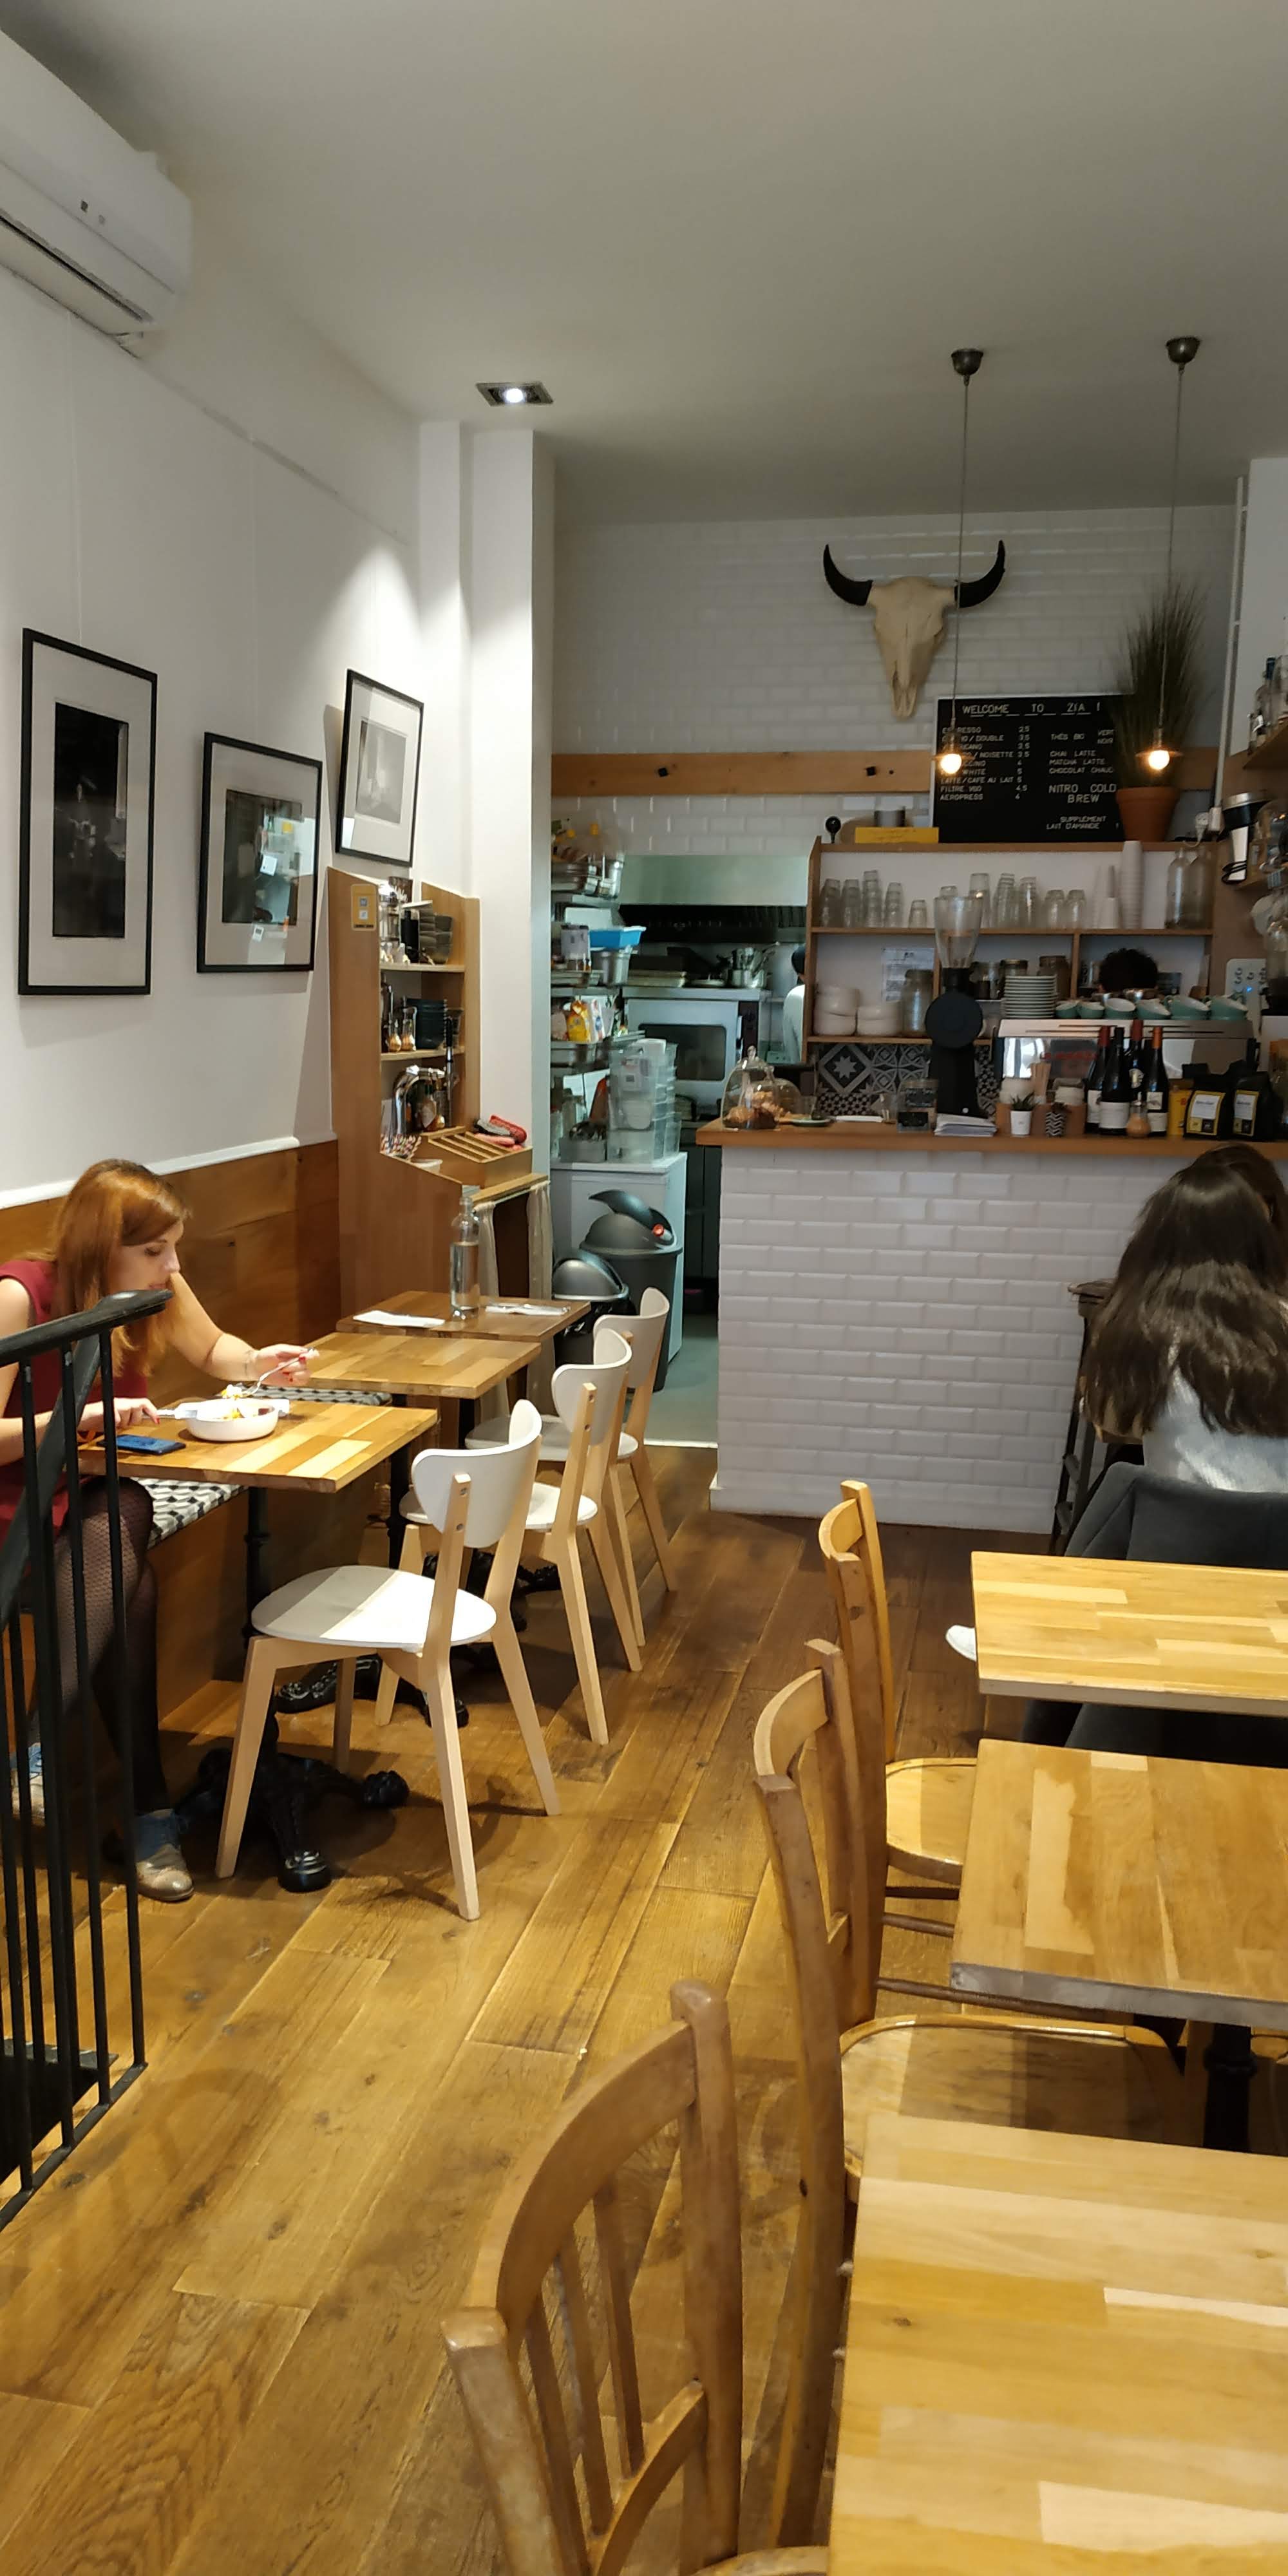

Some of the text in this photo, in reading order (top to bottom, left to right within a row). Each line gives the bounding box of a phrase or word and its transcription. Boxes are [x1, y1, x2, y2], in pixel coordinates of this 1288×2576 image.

[962, 704, 1009, 714] WELCOME
[1032, 703, 1044, 713] TO
[1048, 783, 1117, 793] NITRO COLD
[1067, 794, 1100, 804] BREW
